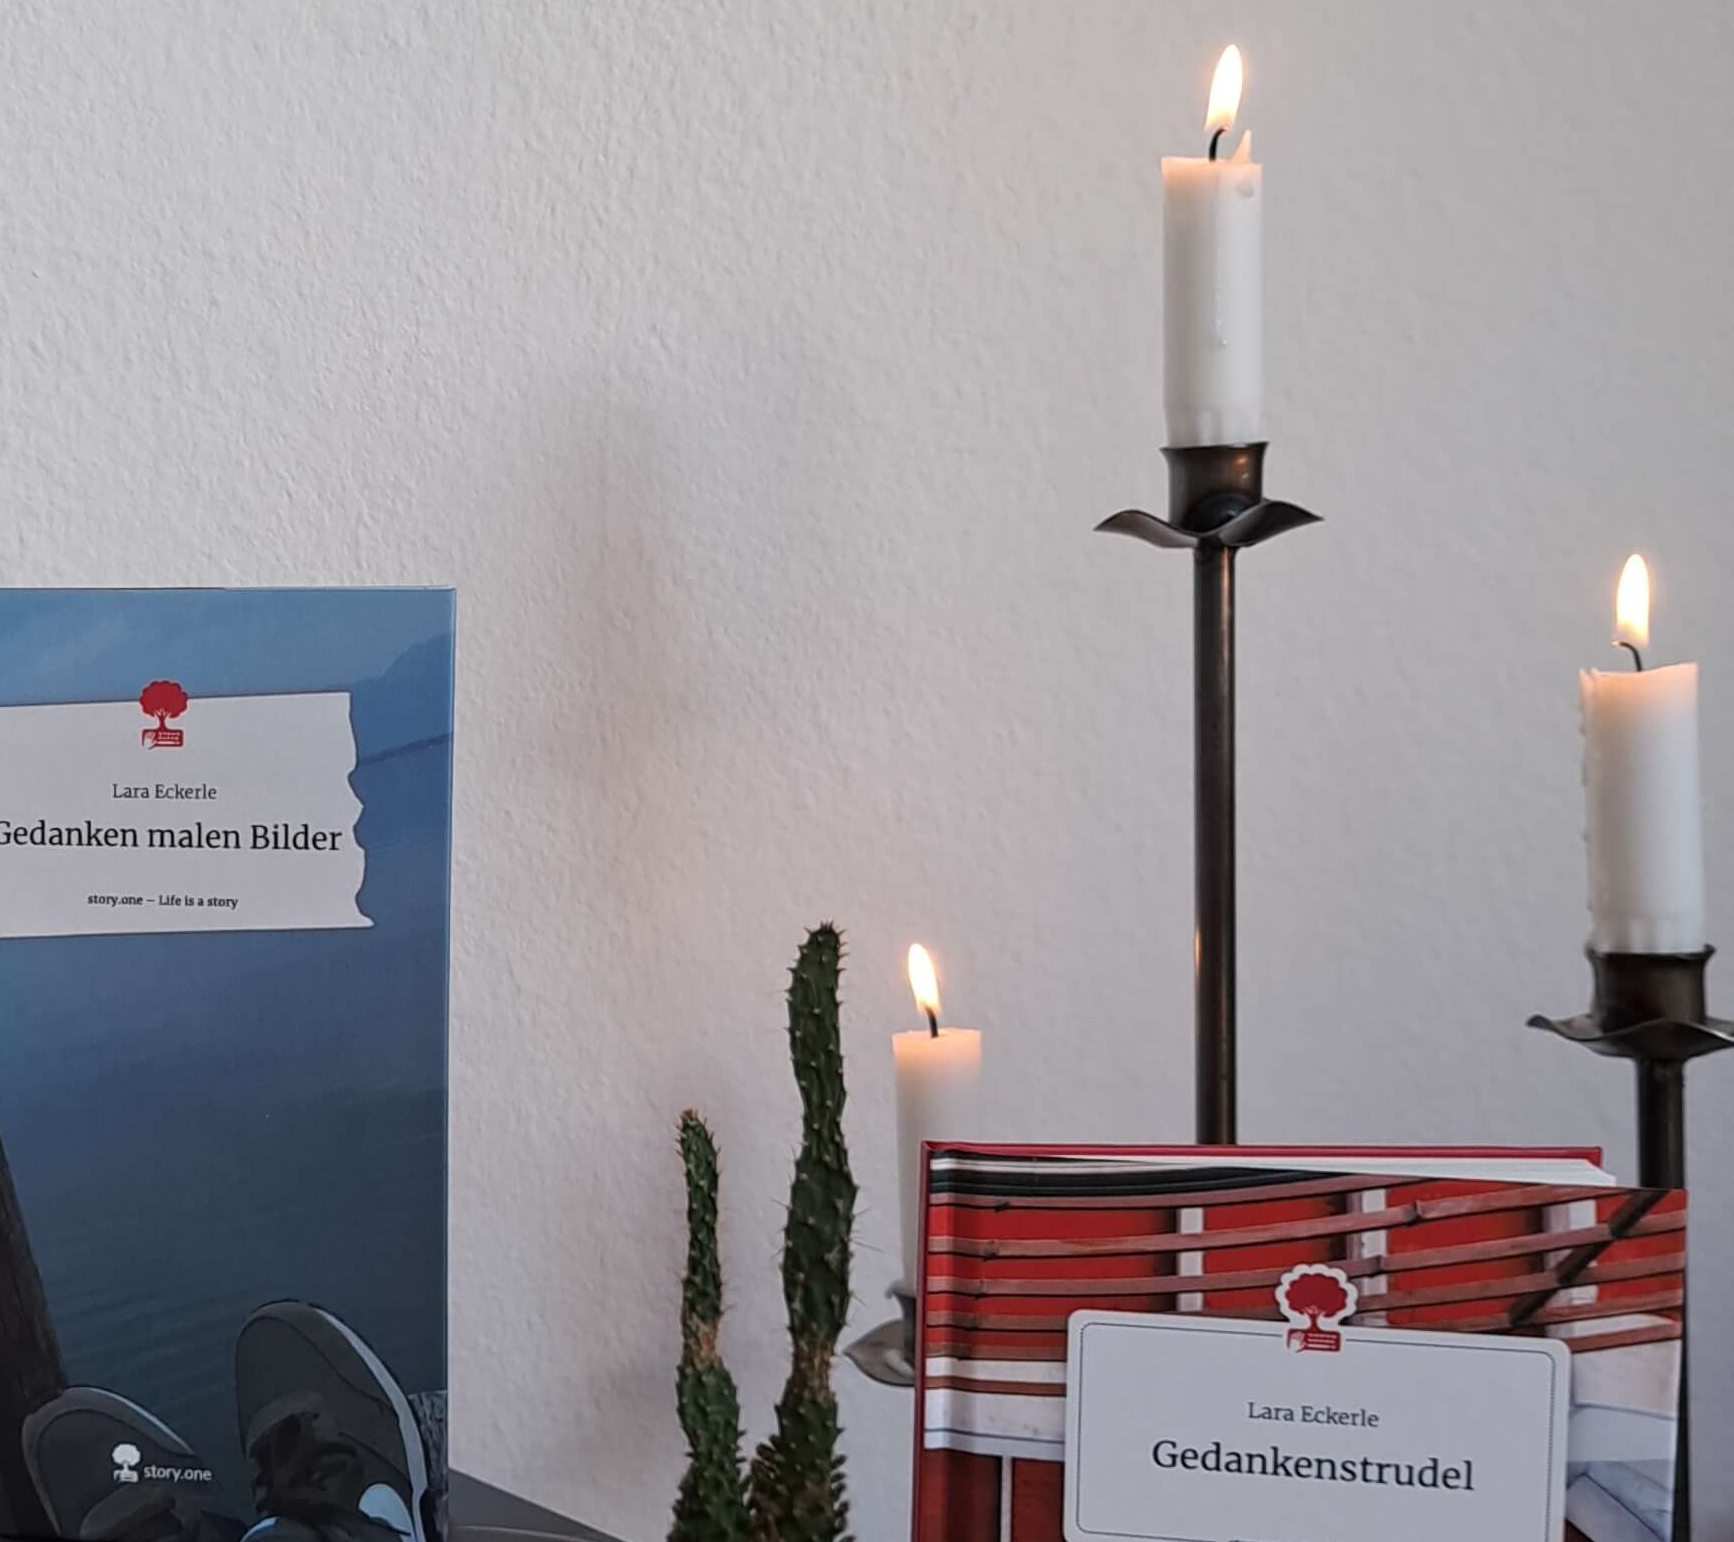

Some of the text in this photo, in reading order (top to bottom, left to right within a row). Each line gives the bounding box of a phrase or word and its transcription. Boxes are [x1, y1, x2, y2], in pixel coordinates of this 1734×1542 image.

[112, 783, 218, 801] Lara Eckerle
[147, 822, 242, 850] malen
[249, 823, 343, 852] Bilder
[87, 893, 144, 908] story.one
[158, 893, 182, 908] Life
[184, 895, 195, 908] is
[197, 898, 205, 908] a
[206, 896, 239, 911] story
[1247, 1400, 1380, 1429] Lara Eckerle
[143, 1464, 213, 1482] story.one
[1151, 1438, 1475, 1492] Gedankenstrudel
